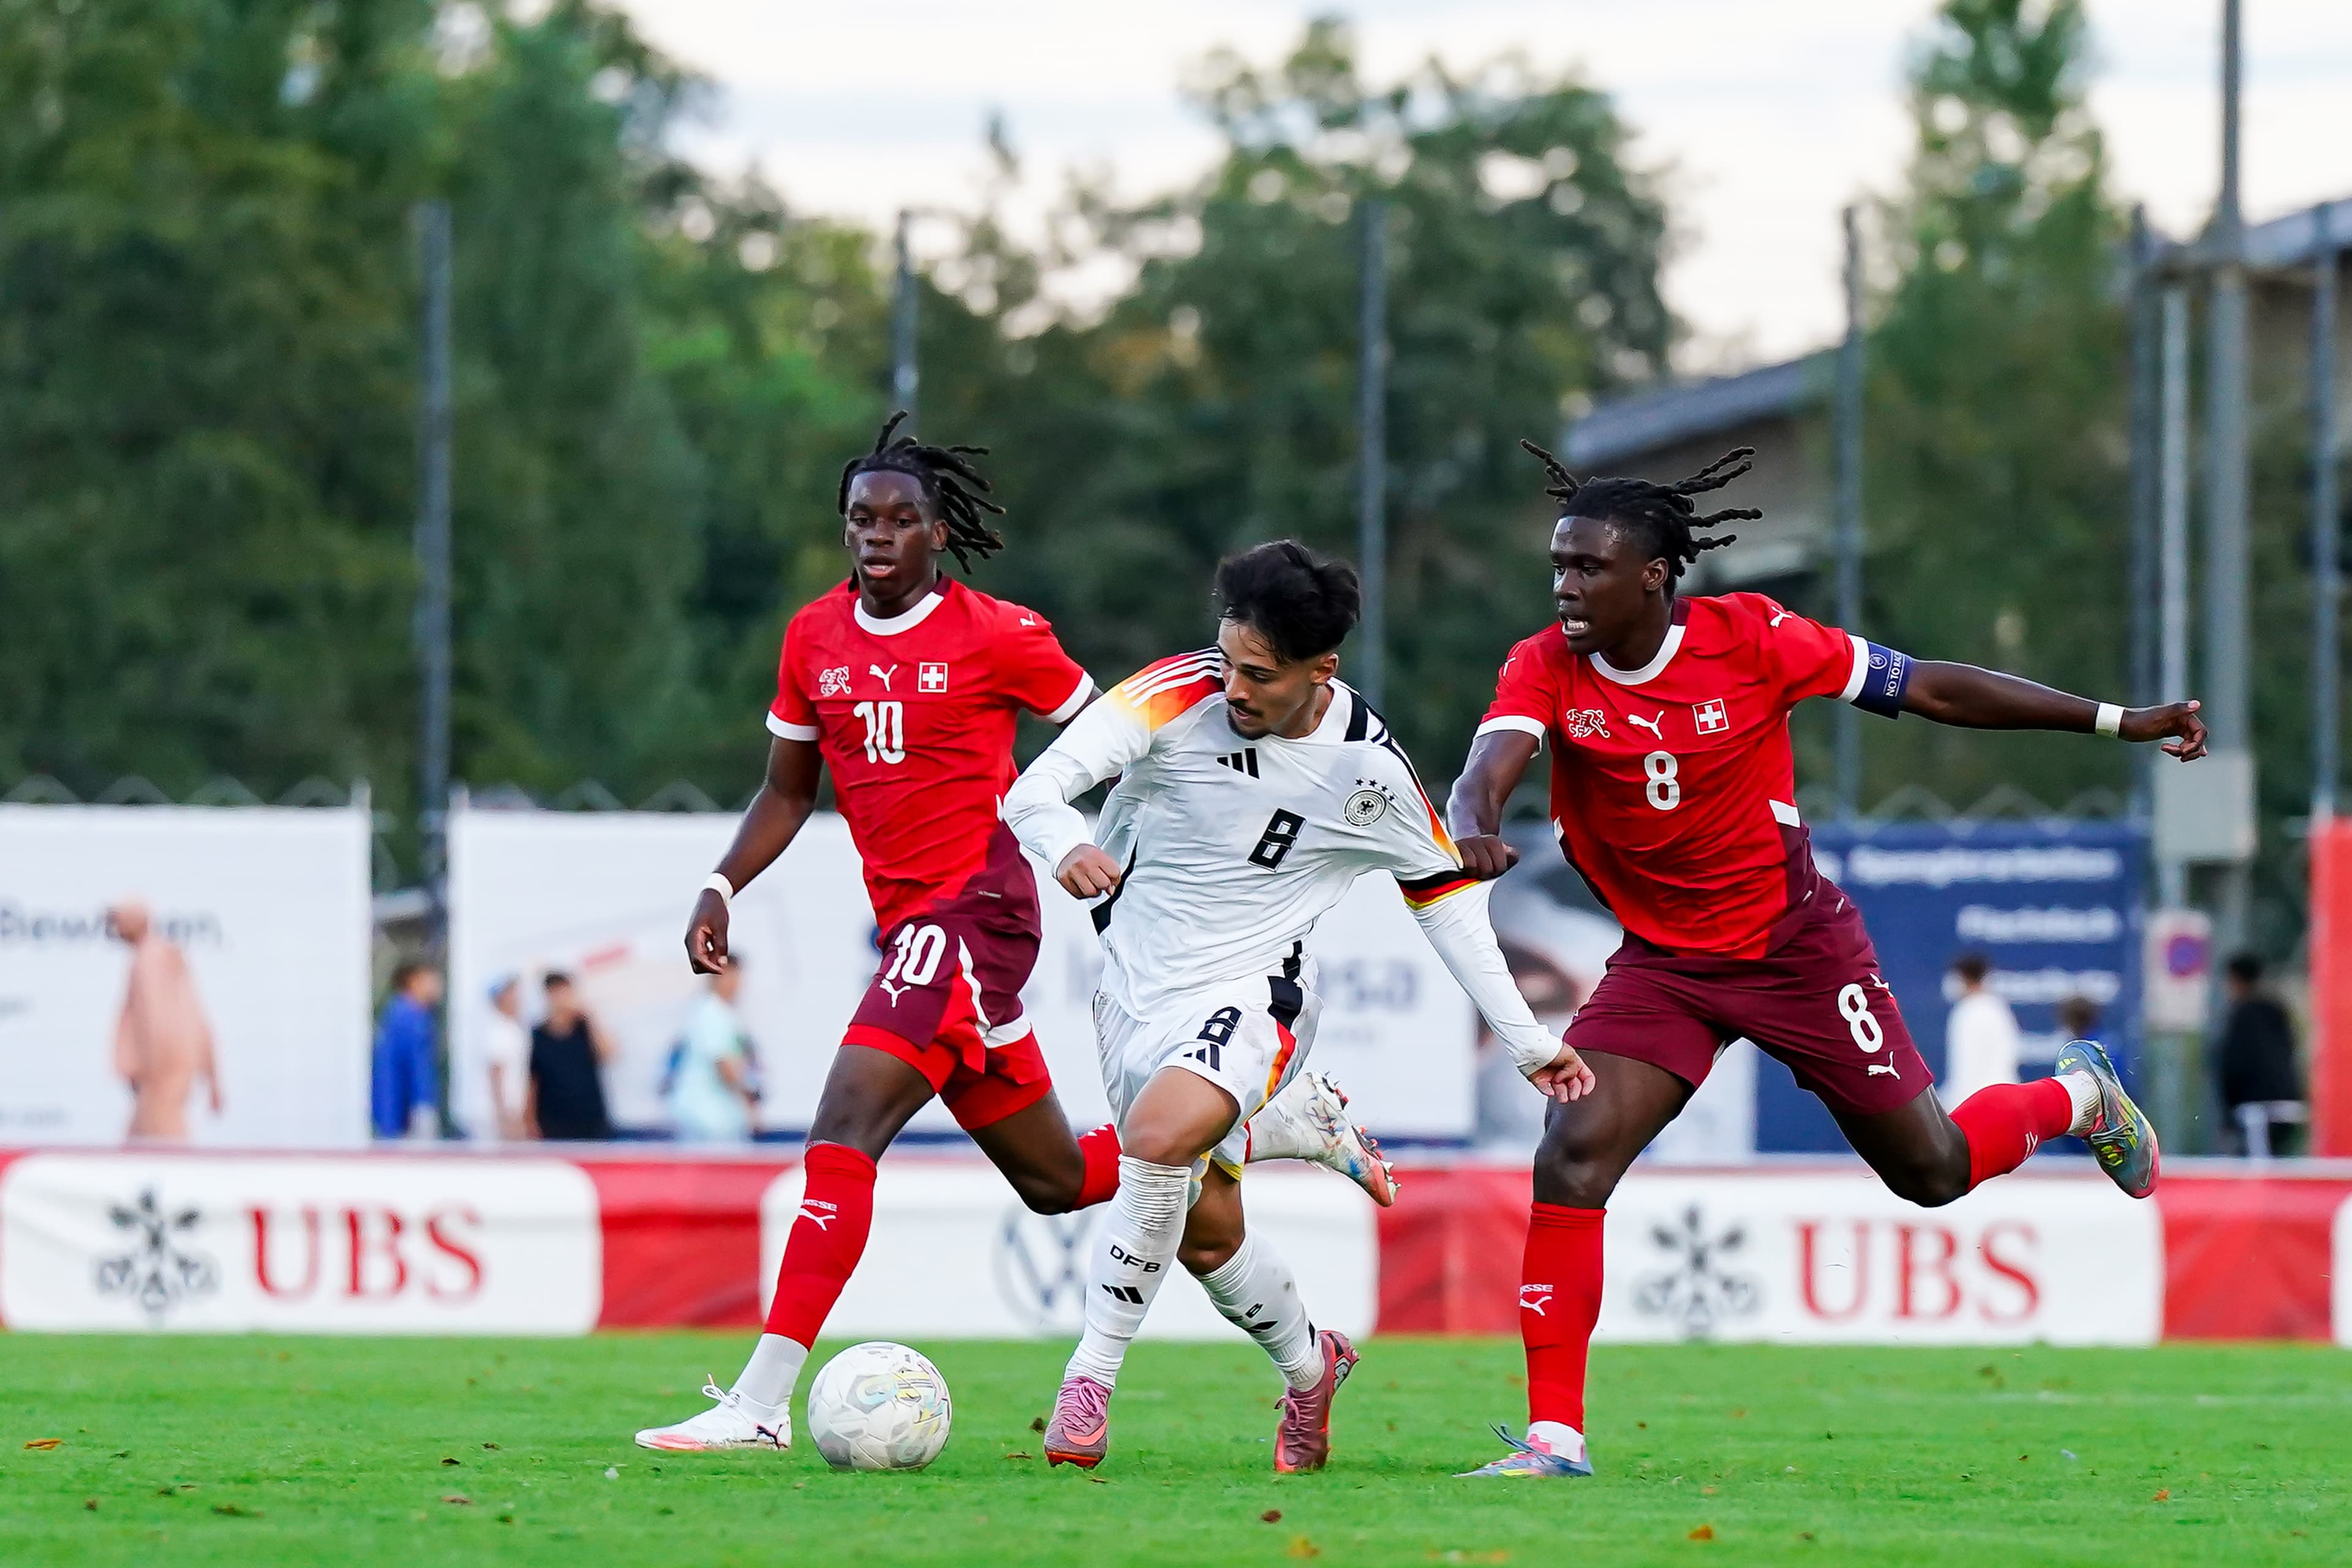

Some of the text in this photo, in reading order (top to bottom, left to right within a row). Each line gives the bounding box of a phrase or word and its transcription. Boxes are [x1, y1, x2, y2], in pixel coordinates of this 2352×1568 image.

[1886, 681, 1897, 696] NO
[1890, 668, 1900, 679] TO
[853, 701, 905, 764] 10
[1644, 750, 1680, 810] 8
[1247, 807, 1307, 873] 8
[885, 924, 947, 986] 10
[1196, 1006, 1243, 1047] 8
[1838, 983, 1884, 1053] 8
[247, 1202, 487, 1306] UBS
[1110, 1244, 1161, 1272] DFB
[1793, 1219, 2042, 1325] UBS
